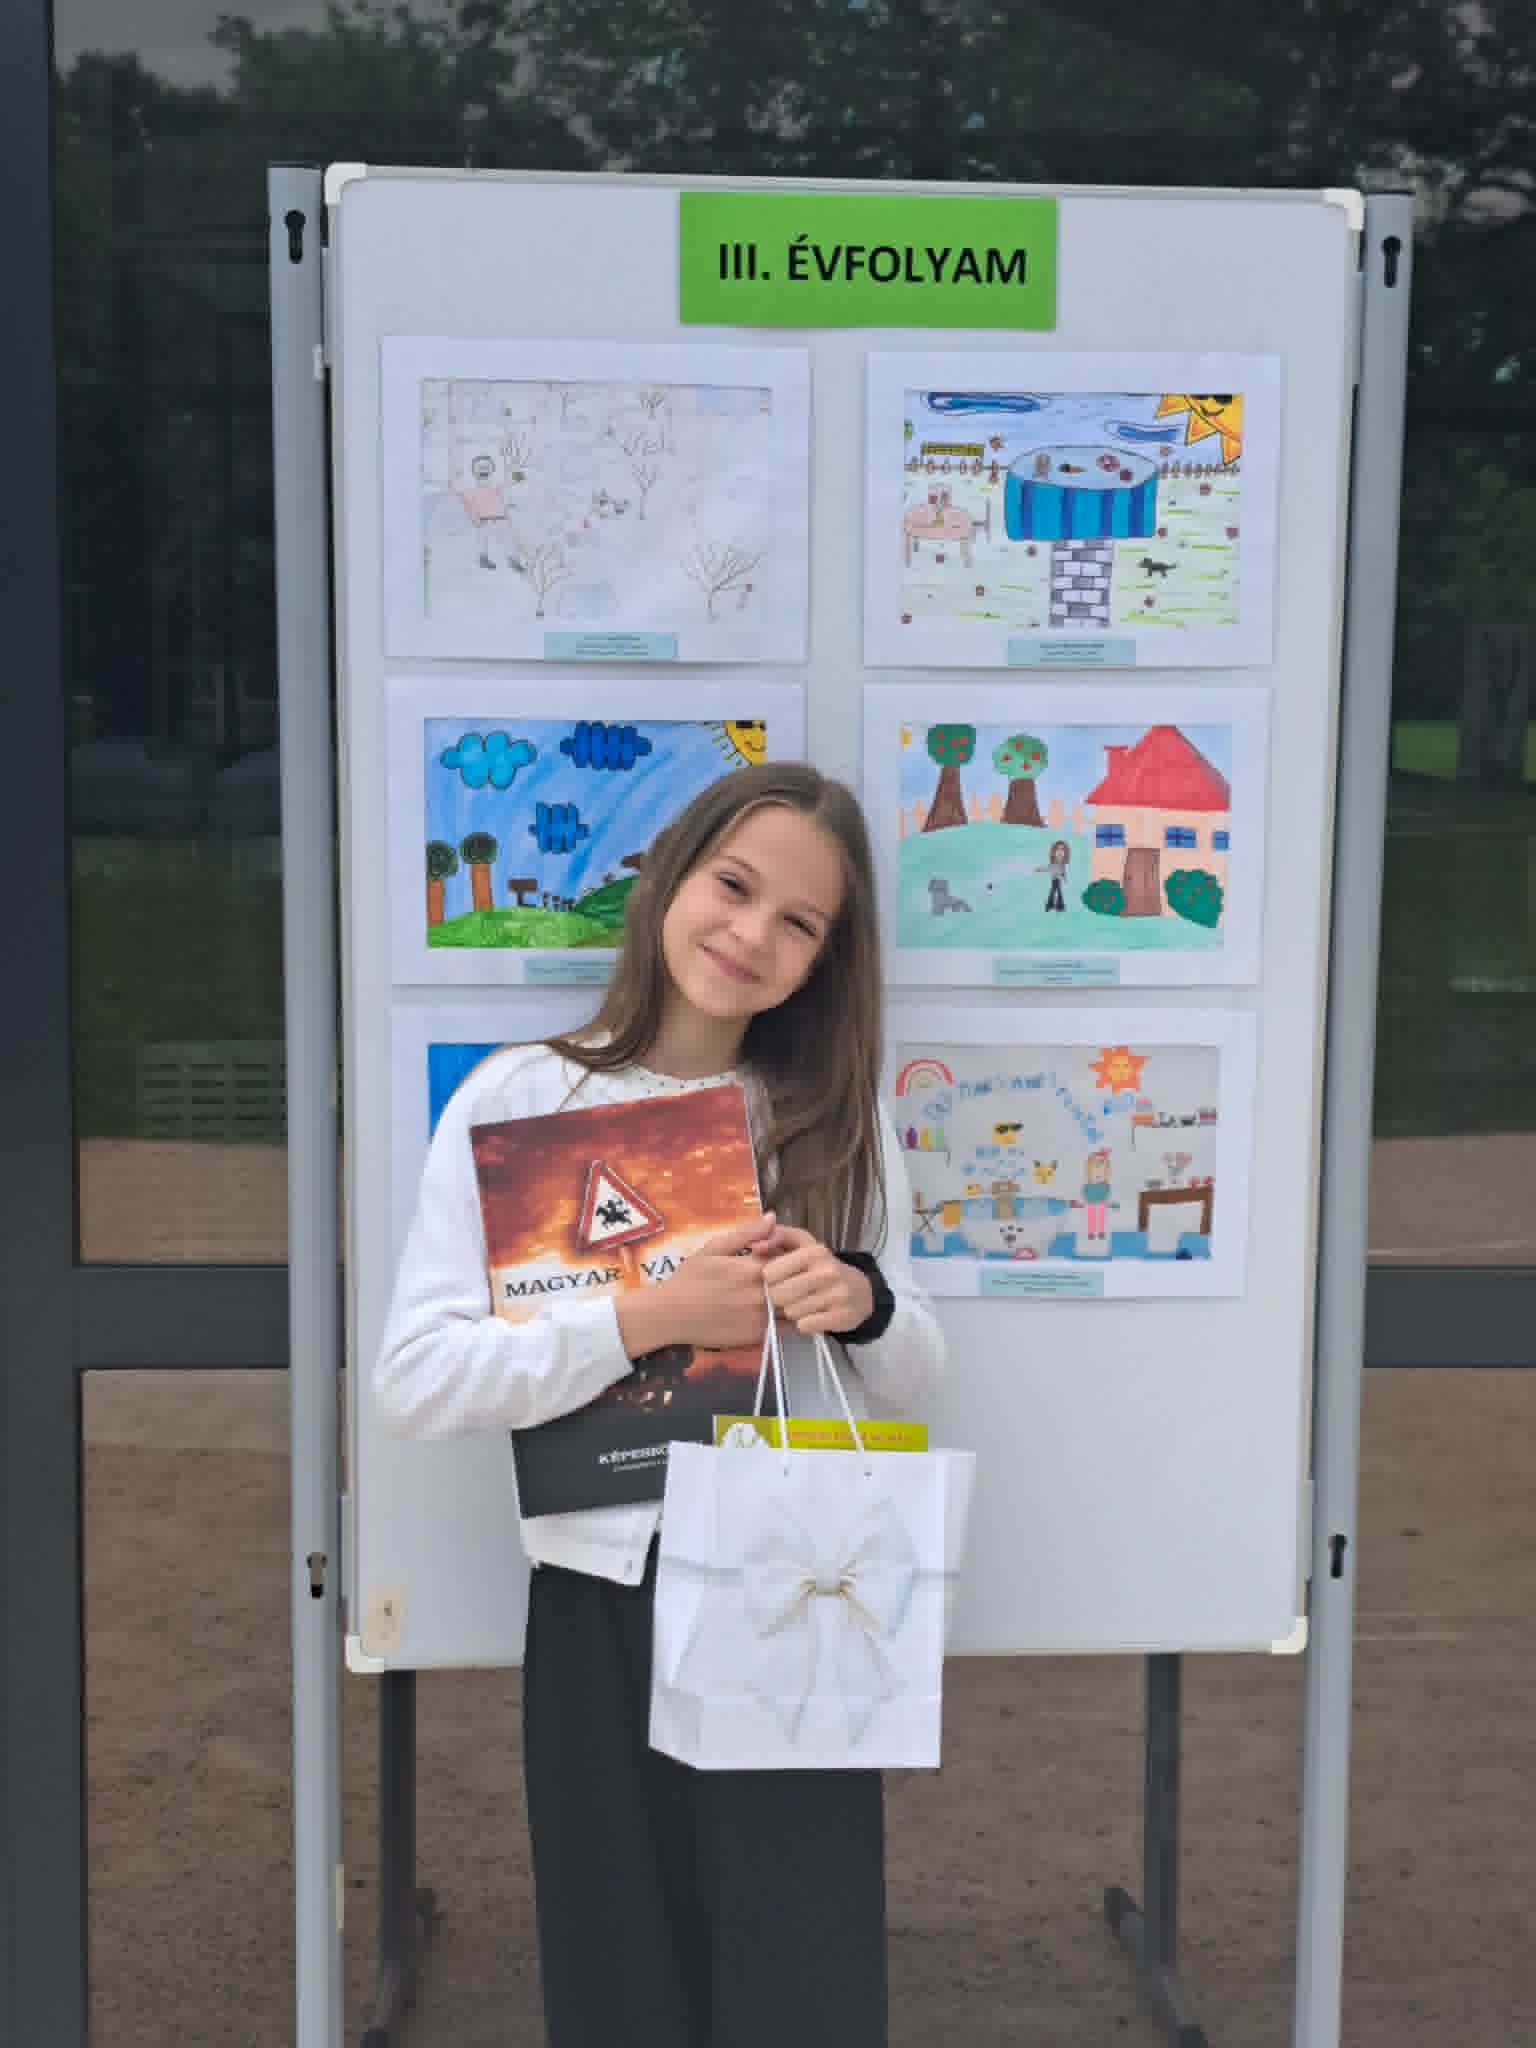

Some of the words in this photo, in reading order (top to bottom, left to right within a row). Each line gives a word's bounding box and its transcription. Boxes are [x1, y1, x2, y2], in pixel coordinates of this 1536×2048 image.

[718, 243, 770, 281] III.
[787, 233, 1028, 285] ÉVFOLYAM
[503, 1267, 624, 1298] MAGYAR
